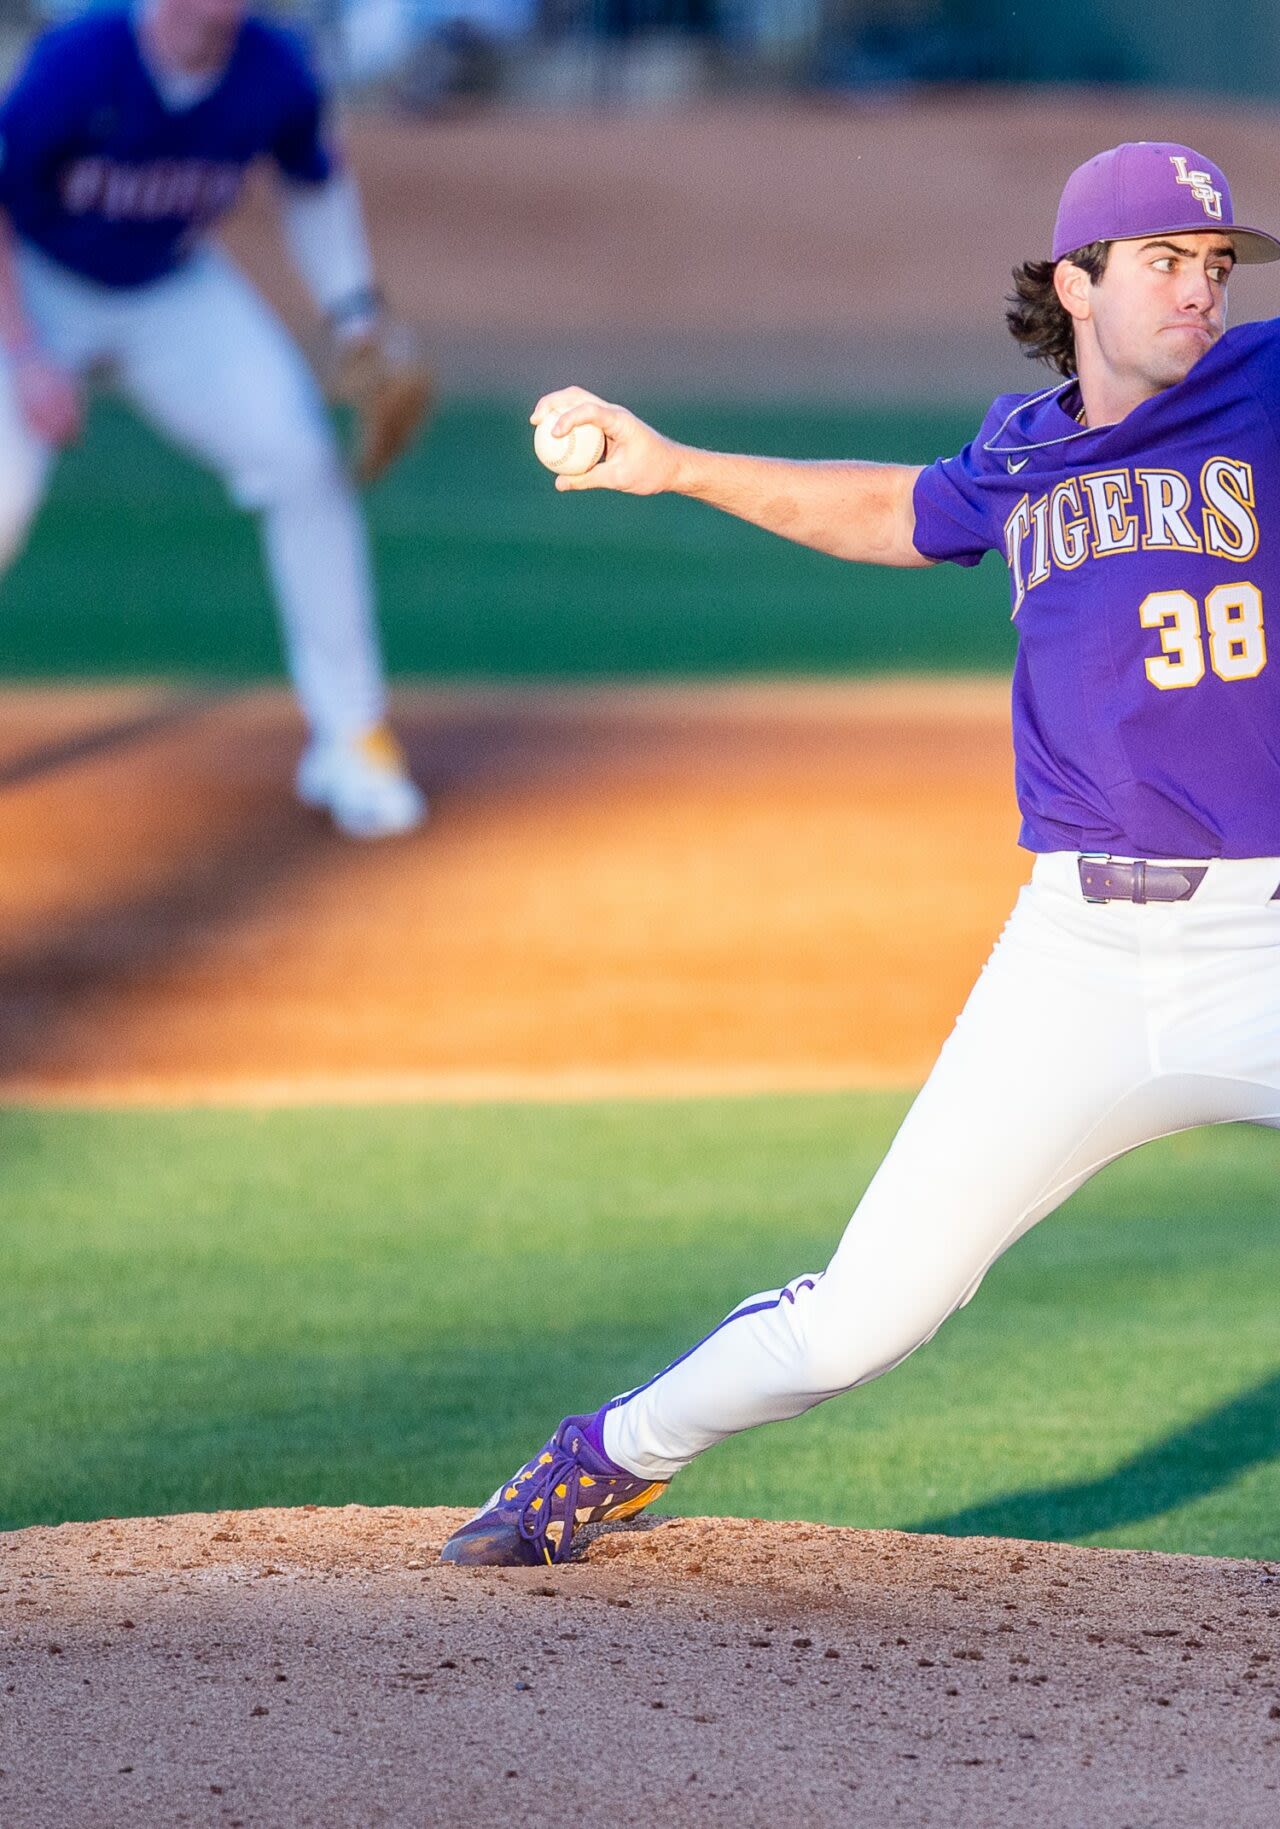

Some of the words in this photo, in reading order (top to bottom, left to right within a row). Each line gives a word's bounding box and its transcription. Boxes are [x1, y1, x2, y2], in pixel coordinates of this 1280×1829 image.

[1169, 156, 1223, 220] LSU
[1004, 456, 1260, 620] TIGERS
[1139, 581, 1267, 690] 38
